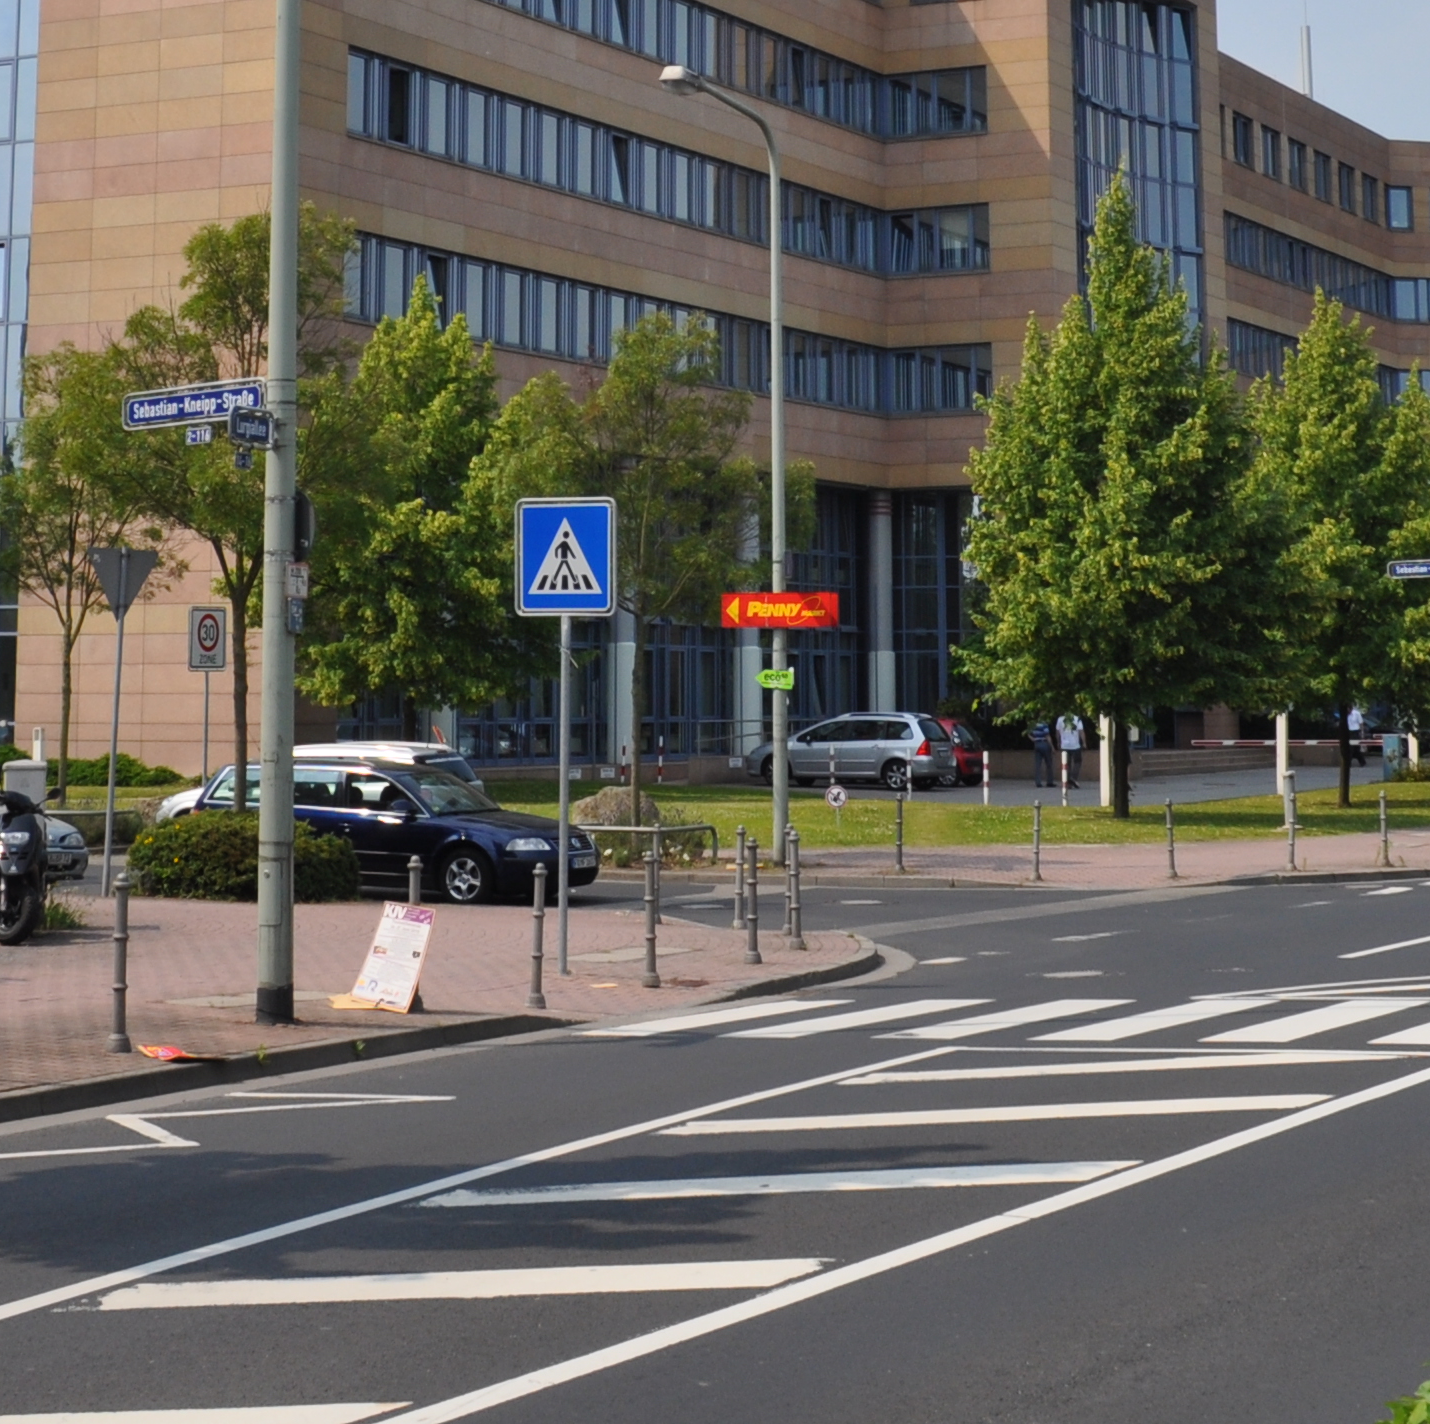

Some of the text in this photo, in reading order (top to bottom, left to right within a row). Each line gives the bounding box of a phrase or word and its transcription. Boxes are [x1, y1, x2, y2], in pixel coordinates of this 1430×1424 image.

[132, 389, 255, 420] Sebastian-Kneipp-Straße
[746, 600, 802, 617] PENNY
[201, 623, 216, 642] 30
[198, 653, 217, 665] ZONE
